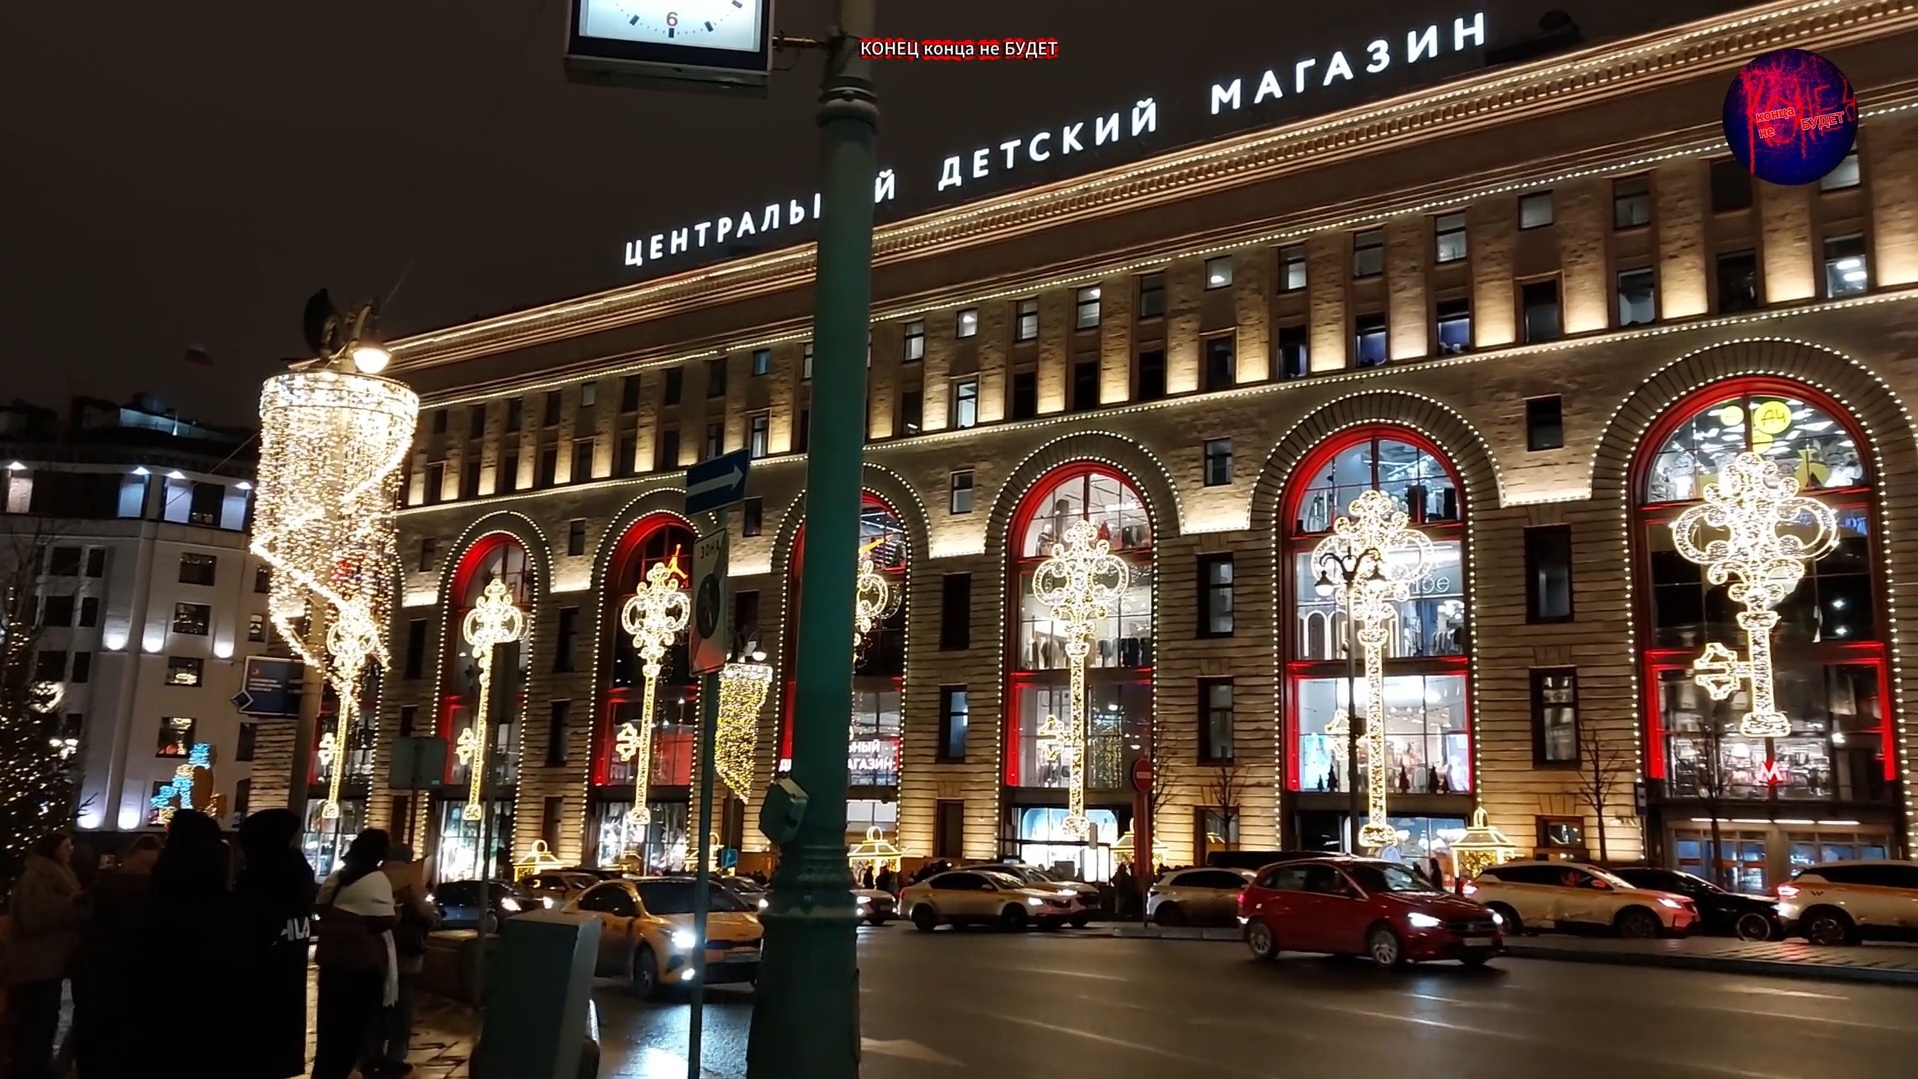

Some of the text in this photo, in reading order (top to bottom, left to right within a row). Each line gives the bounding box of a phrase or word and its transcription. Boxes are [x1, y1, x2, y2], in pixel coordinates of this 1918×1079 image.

[666, 11, 678, 27] 6
[624, 12, 1485, 267] ЦЕНТРАЛЬЙ ДЕТСКИЙ МАГАЗИН
